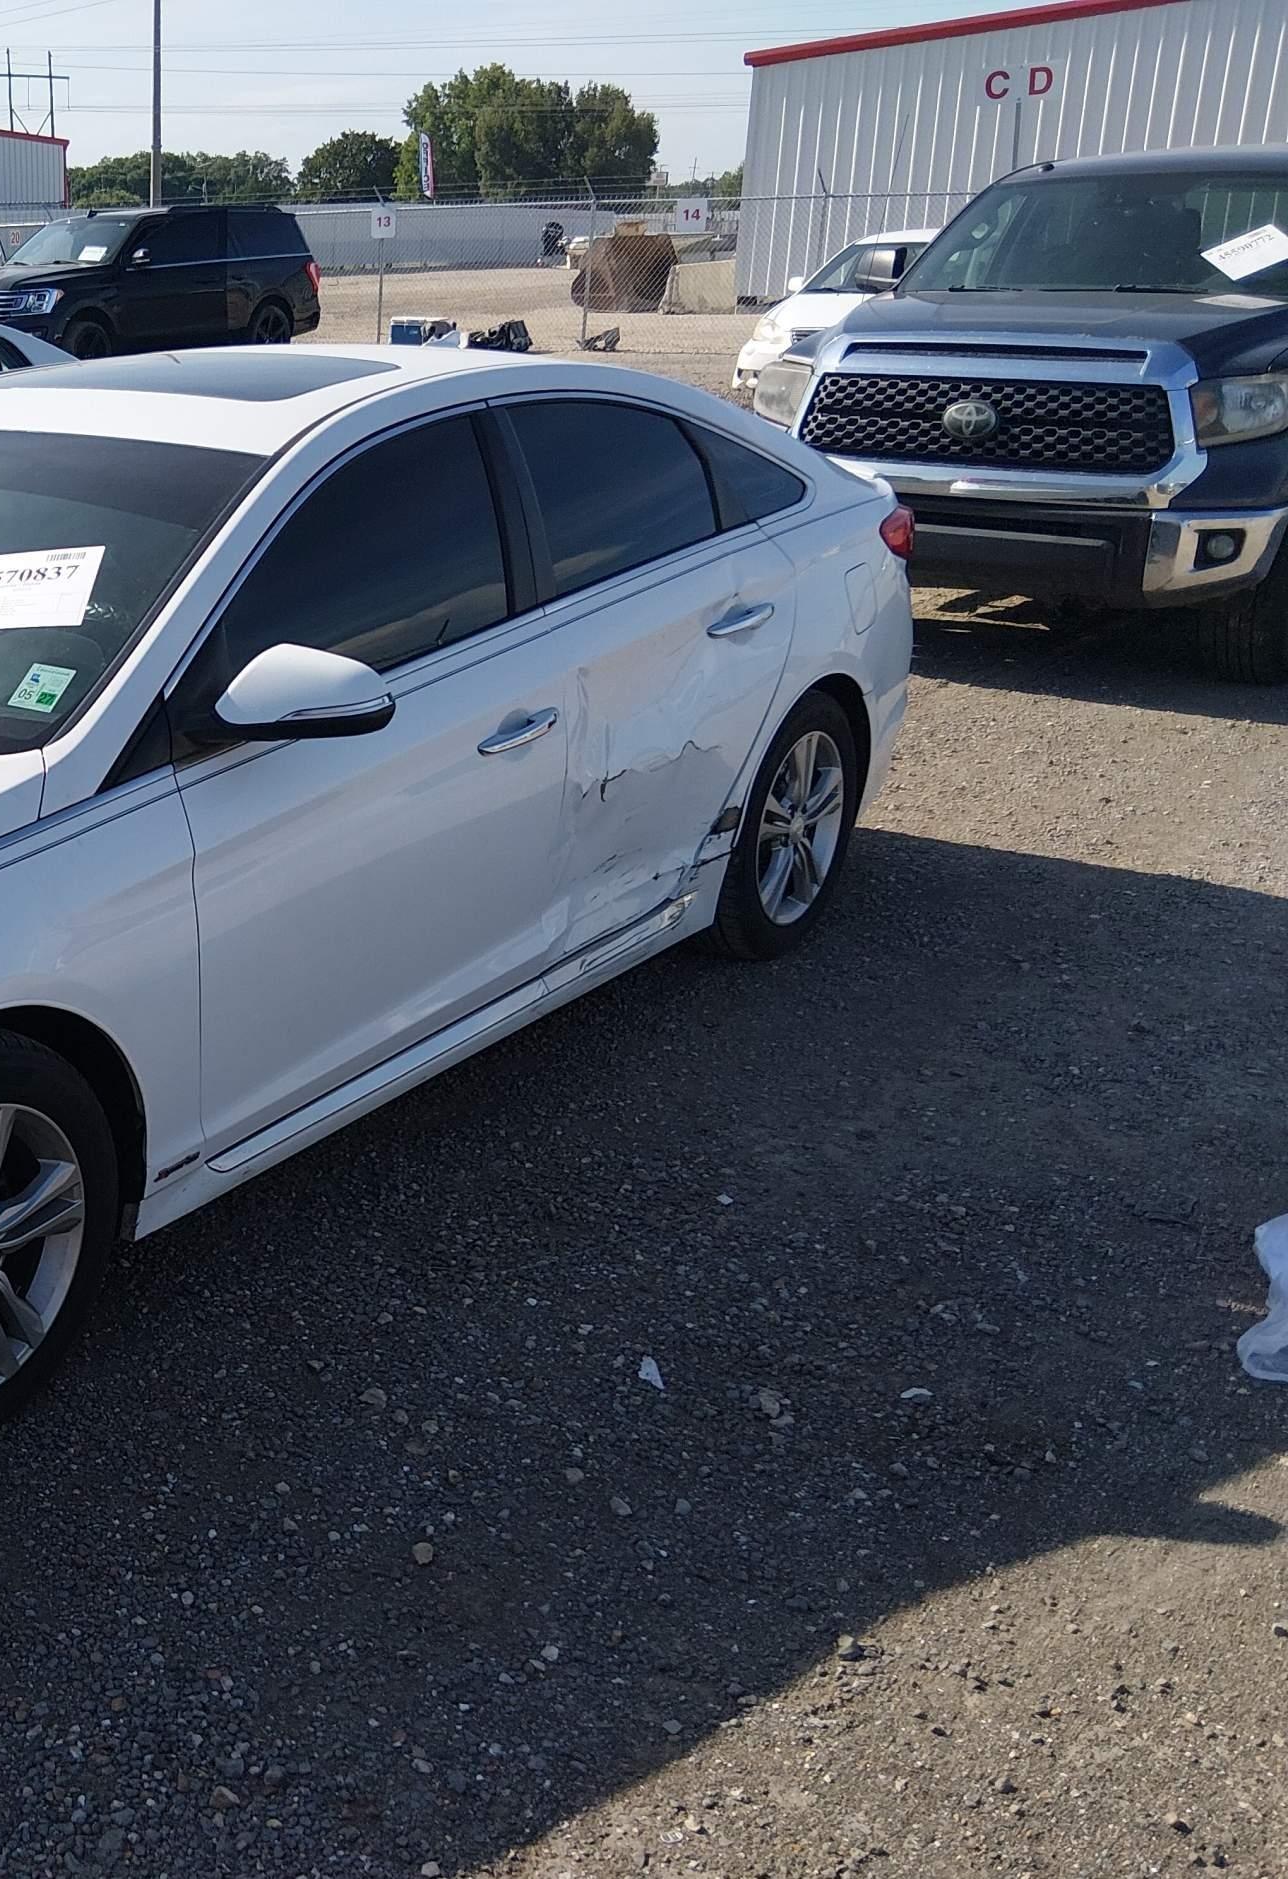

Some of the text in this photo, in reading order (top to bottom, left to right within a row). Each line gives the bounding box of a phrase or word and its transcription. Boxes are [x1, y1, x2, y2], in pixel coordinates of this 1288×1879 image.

[985, 66, 1054, 99] C D
[421, 142, 431, 192] OFFICE
[683, 208, 701, 221] 14
[376, 216, 391, 228] 13
[11, 232, 20, 244] 20
[18, 688, 35, 700] 05
[38, 692, 54, 705] 27
